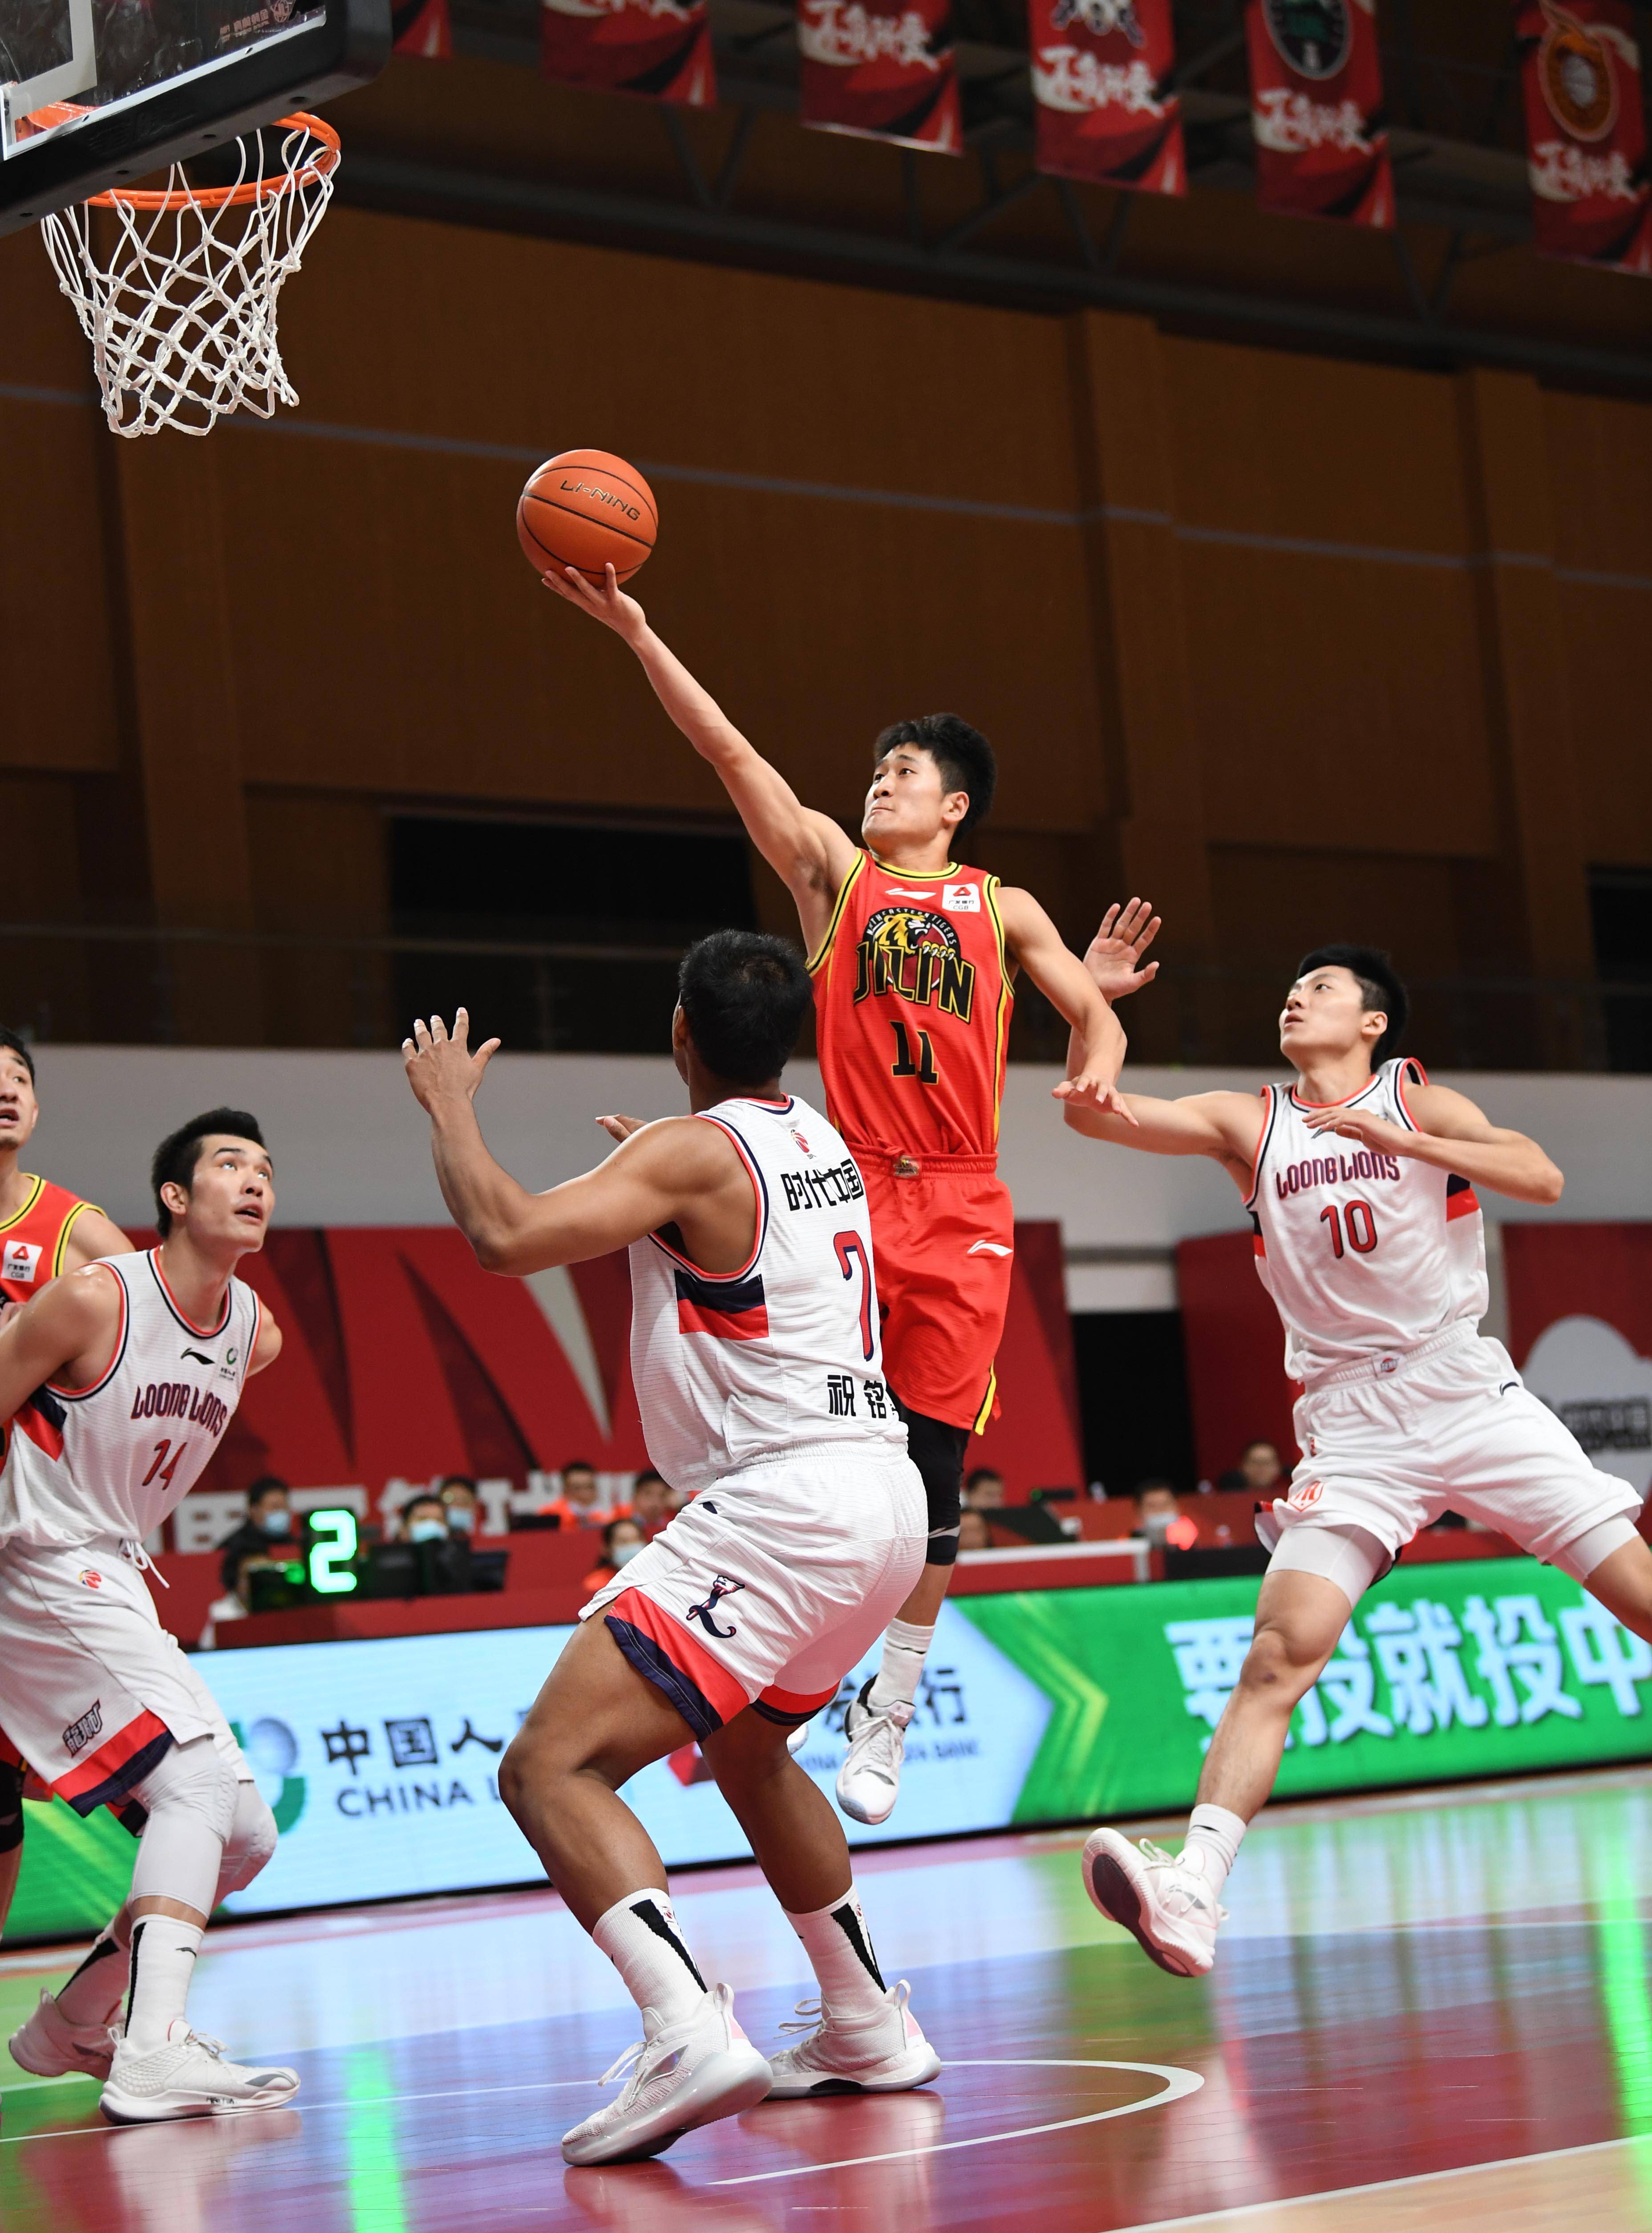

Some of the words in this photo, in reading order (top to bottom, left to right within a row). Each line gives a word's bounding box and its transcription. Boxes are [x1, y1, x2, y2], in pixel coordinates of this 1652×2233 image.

[560, 479, 641, 521] LI-NING
[931, 915, 956, 945] TIGERS
[853, 940, 975, 1025] JILIN
[889, 1019, 939, 1085] 11
[780, 1158, 864, 1211] 时代中国
[1276, 1157, 1338, 1200] LOONG
[1339, 1151, 1401, 1182] LIONS
[1320, 1199, 1378, 1259] 10
[833, 1230, 875, 1362] 7
[827, 1374, 895, 1419] 祝铭
[142, 1438, 187, 1490] 14
[309, 1509, 357, 1593] 2
[321, 1709, 528, 1775] 中国人
[336, 1780, 474, 1818] CHINA
